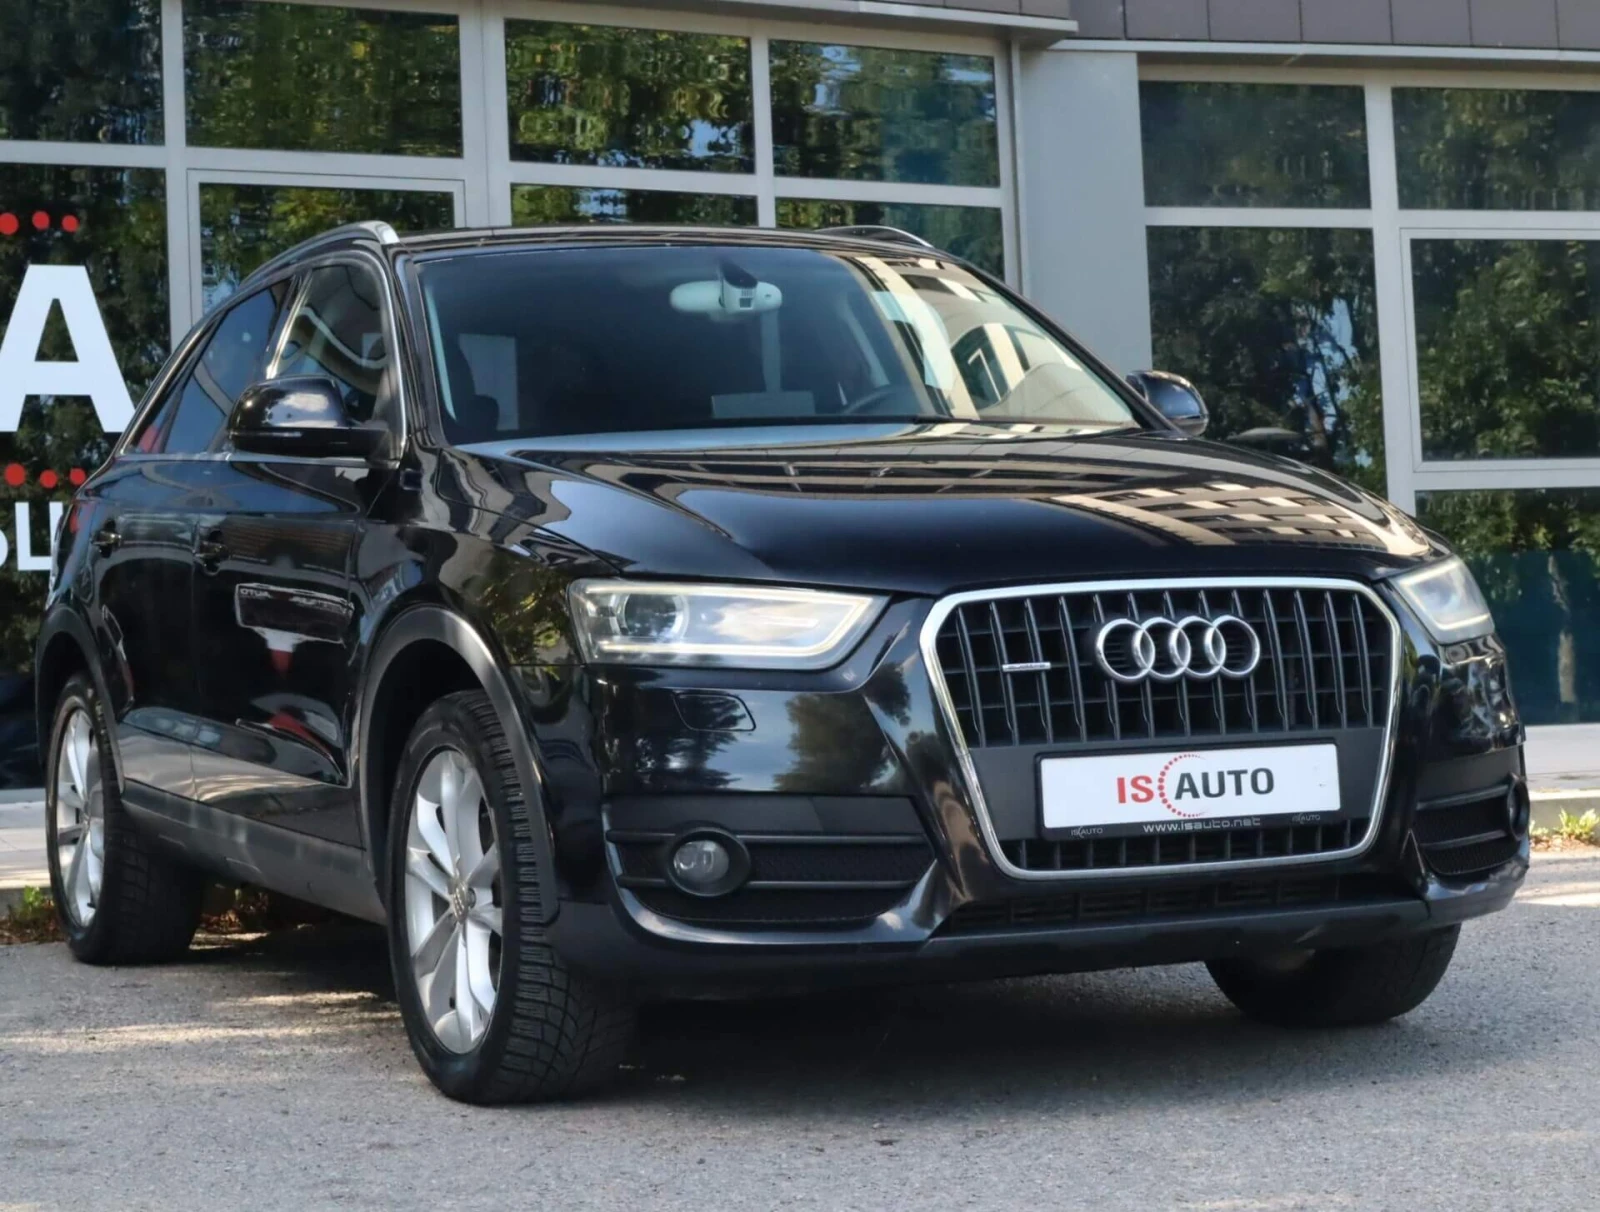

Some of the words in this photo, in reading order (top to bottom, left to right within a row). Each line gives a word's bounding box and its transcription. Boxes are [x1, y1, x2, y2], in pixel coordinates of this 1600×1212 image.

[1116, 775, 1154, 804] IS
[1174, 767, 1274, 800] AUTO
[1142, 816, 1261, 834] www.isauto.net
